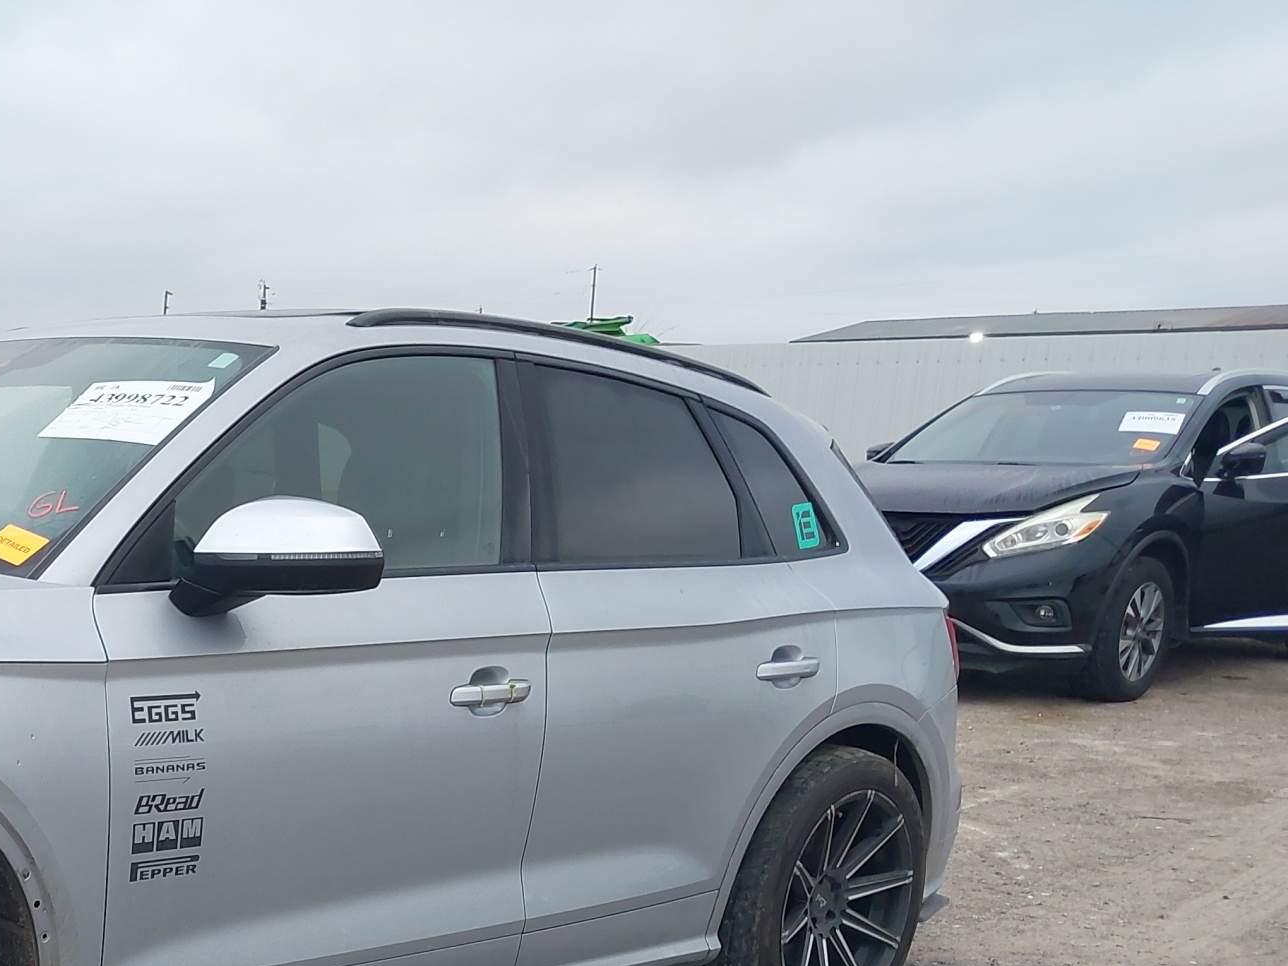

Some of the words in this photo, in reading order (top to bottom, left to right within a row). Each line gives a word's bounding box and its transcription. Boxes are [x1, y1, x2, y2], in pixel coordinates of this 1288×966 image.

[130, 693, 199, 724] EGGS
[134, 761, 206, 776] BANANAS
[132, 817, 203, 851] HAM
